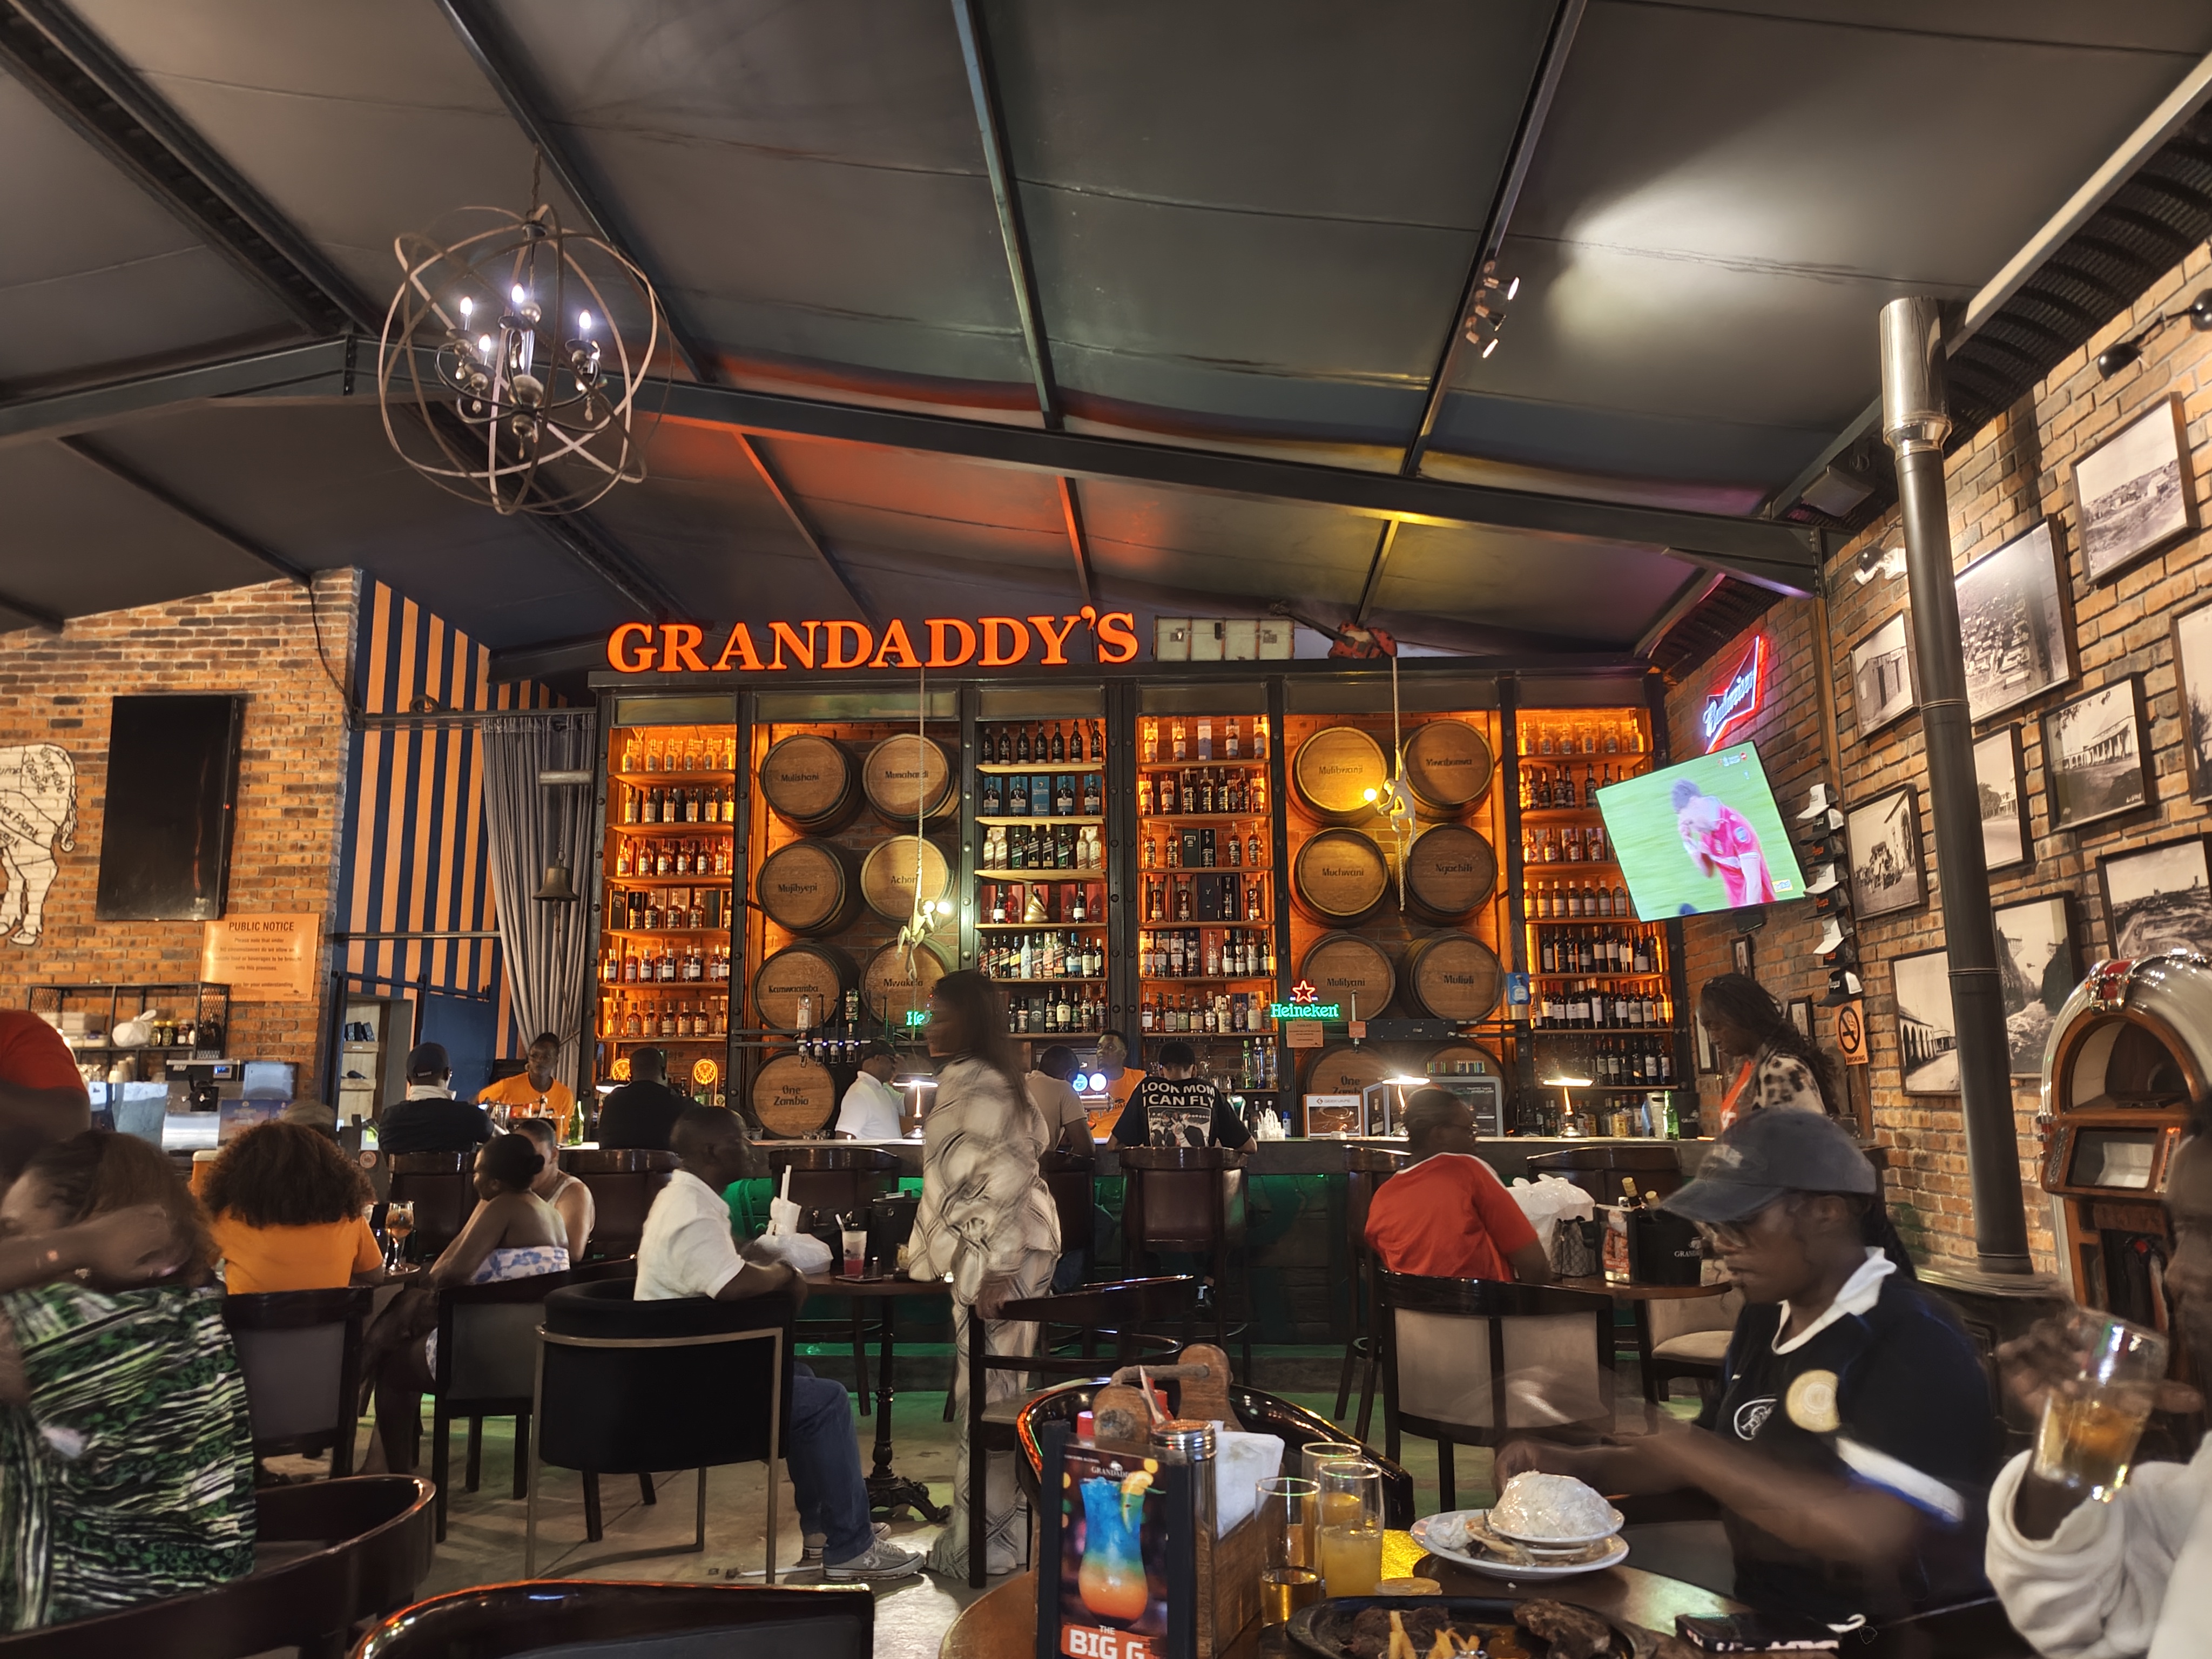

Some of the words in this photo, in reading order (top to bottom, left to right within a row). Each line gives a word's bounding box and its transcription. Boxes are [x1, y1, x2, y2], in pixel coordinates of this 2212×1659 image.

[606, 605, 1139, 673] GRANDADDY'S
[781, 773, 819, 782] Mulishani
[229, 921, 260, 932] PUBLIC
[263, 921, 294, 932] NOTICE
[1270, 1003, 1339, 1017] Heineken
[1340, 1076, 1360, 1085] One
[783, 1084, 801, 1095] One
[1183, 1084, 1216, 1097] MOM
[773, 1096, 810, 1106] Zambia
[1143, 1096, 1147, 1107] I
[1148, 1094, 1185, 1106] CAN
[1190, 1095, 1215, 1108] FLY
[1098, 1624, 1116, 1635] THE
[1069, 1628, 1118, 1659] BIG
